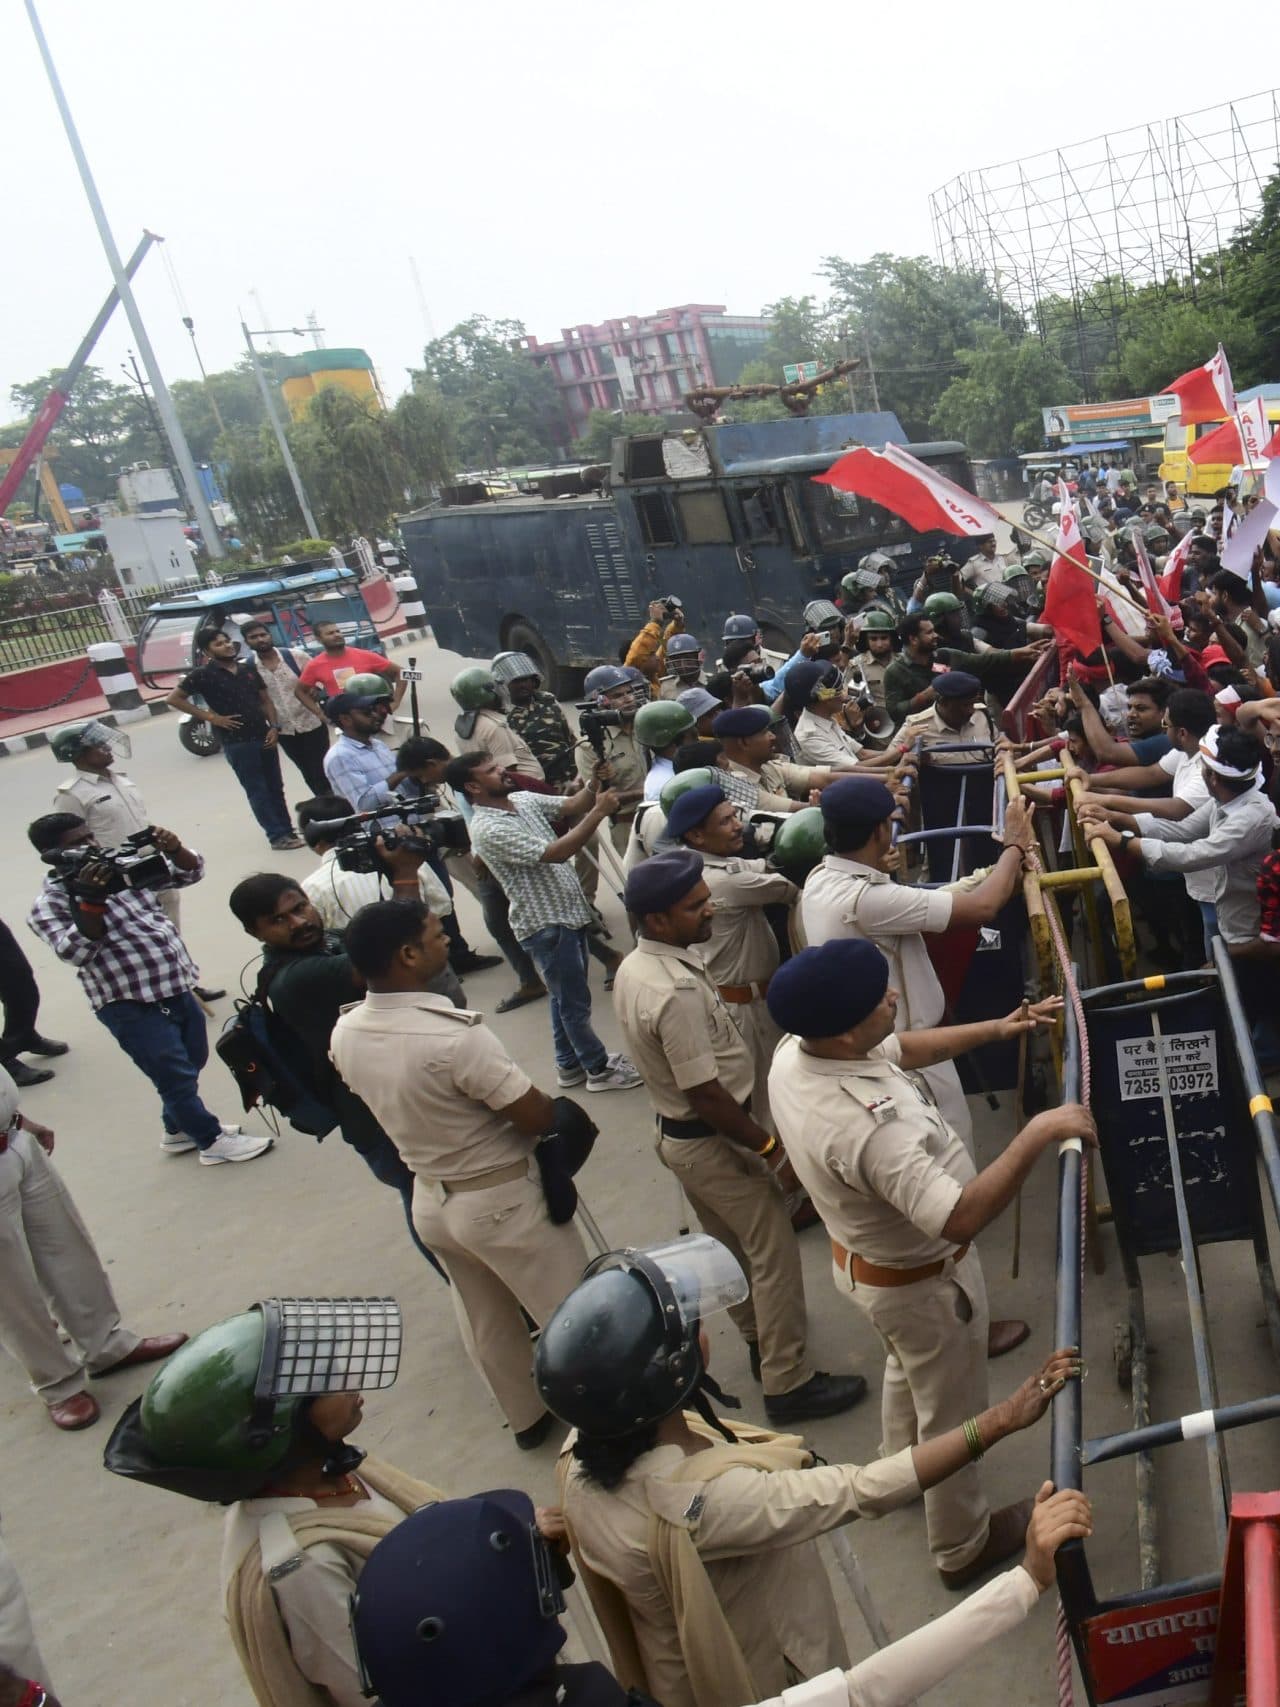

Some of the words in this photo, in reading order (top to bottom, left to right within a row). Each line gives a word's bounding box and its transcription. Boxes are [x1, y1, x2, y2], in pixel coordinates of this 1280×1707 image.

[1123, 1044, 1142, 1056] घर
[1170, 1034, 1210, 1051] लिखने
[1134, 1057, 1158, 1067] वाला
[1101, 1606, 1219, 1646] याताया
